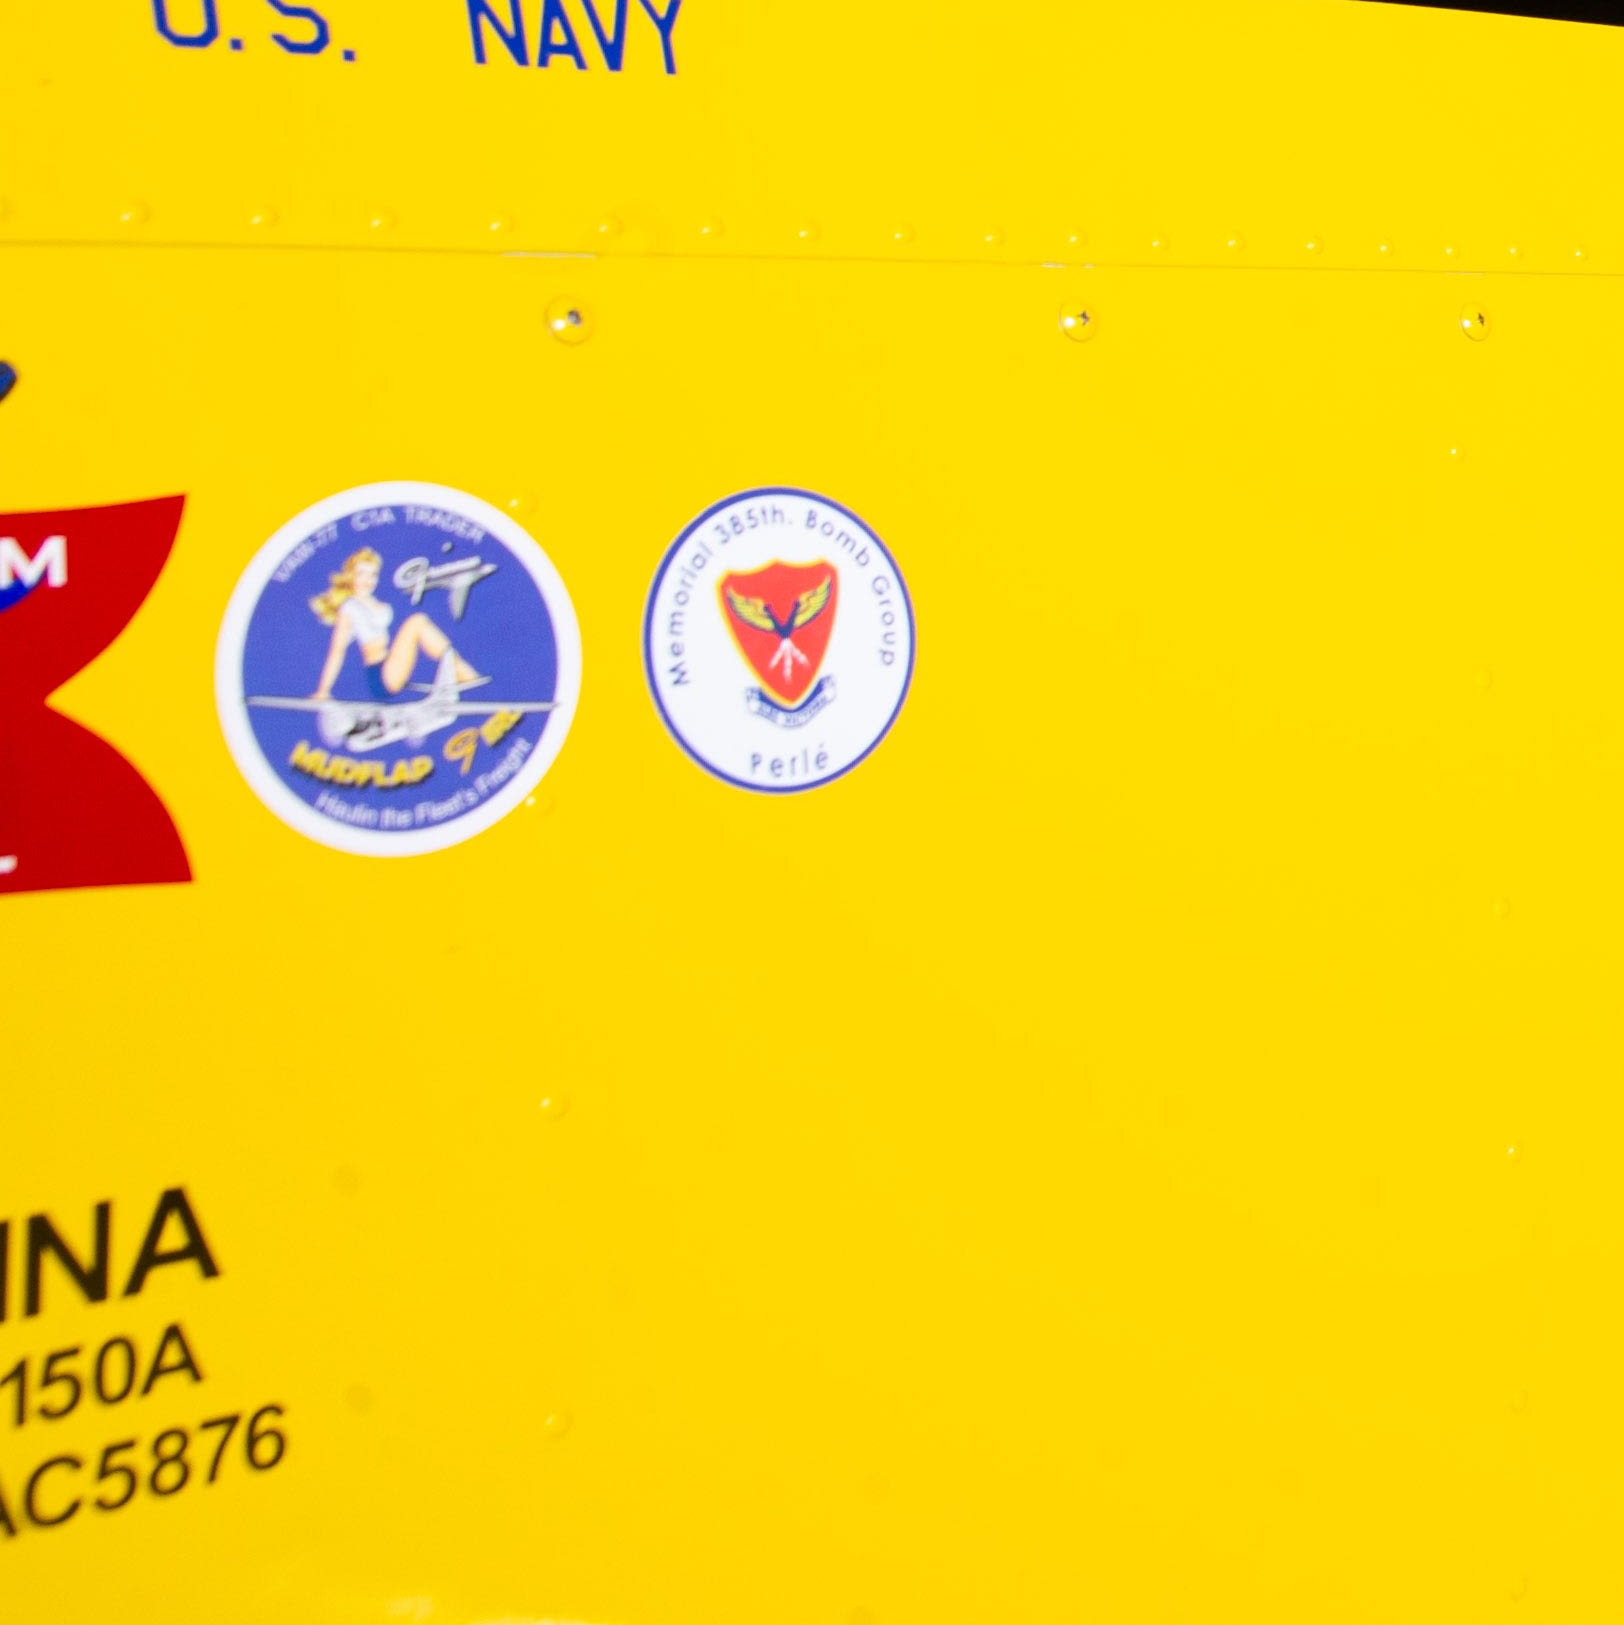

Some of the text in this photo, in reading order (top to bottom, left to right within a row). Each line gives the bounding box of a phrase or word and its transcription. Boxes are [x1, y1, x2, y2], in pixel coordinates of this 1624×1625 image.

[667, 541, 714, 687] Memorial
[804, 508, 871, 568] Bomb
[871, 575, 897, 668] Group
[750, 742, 831, 778] Perlé
